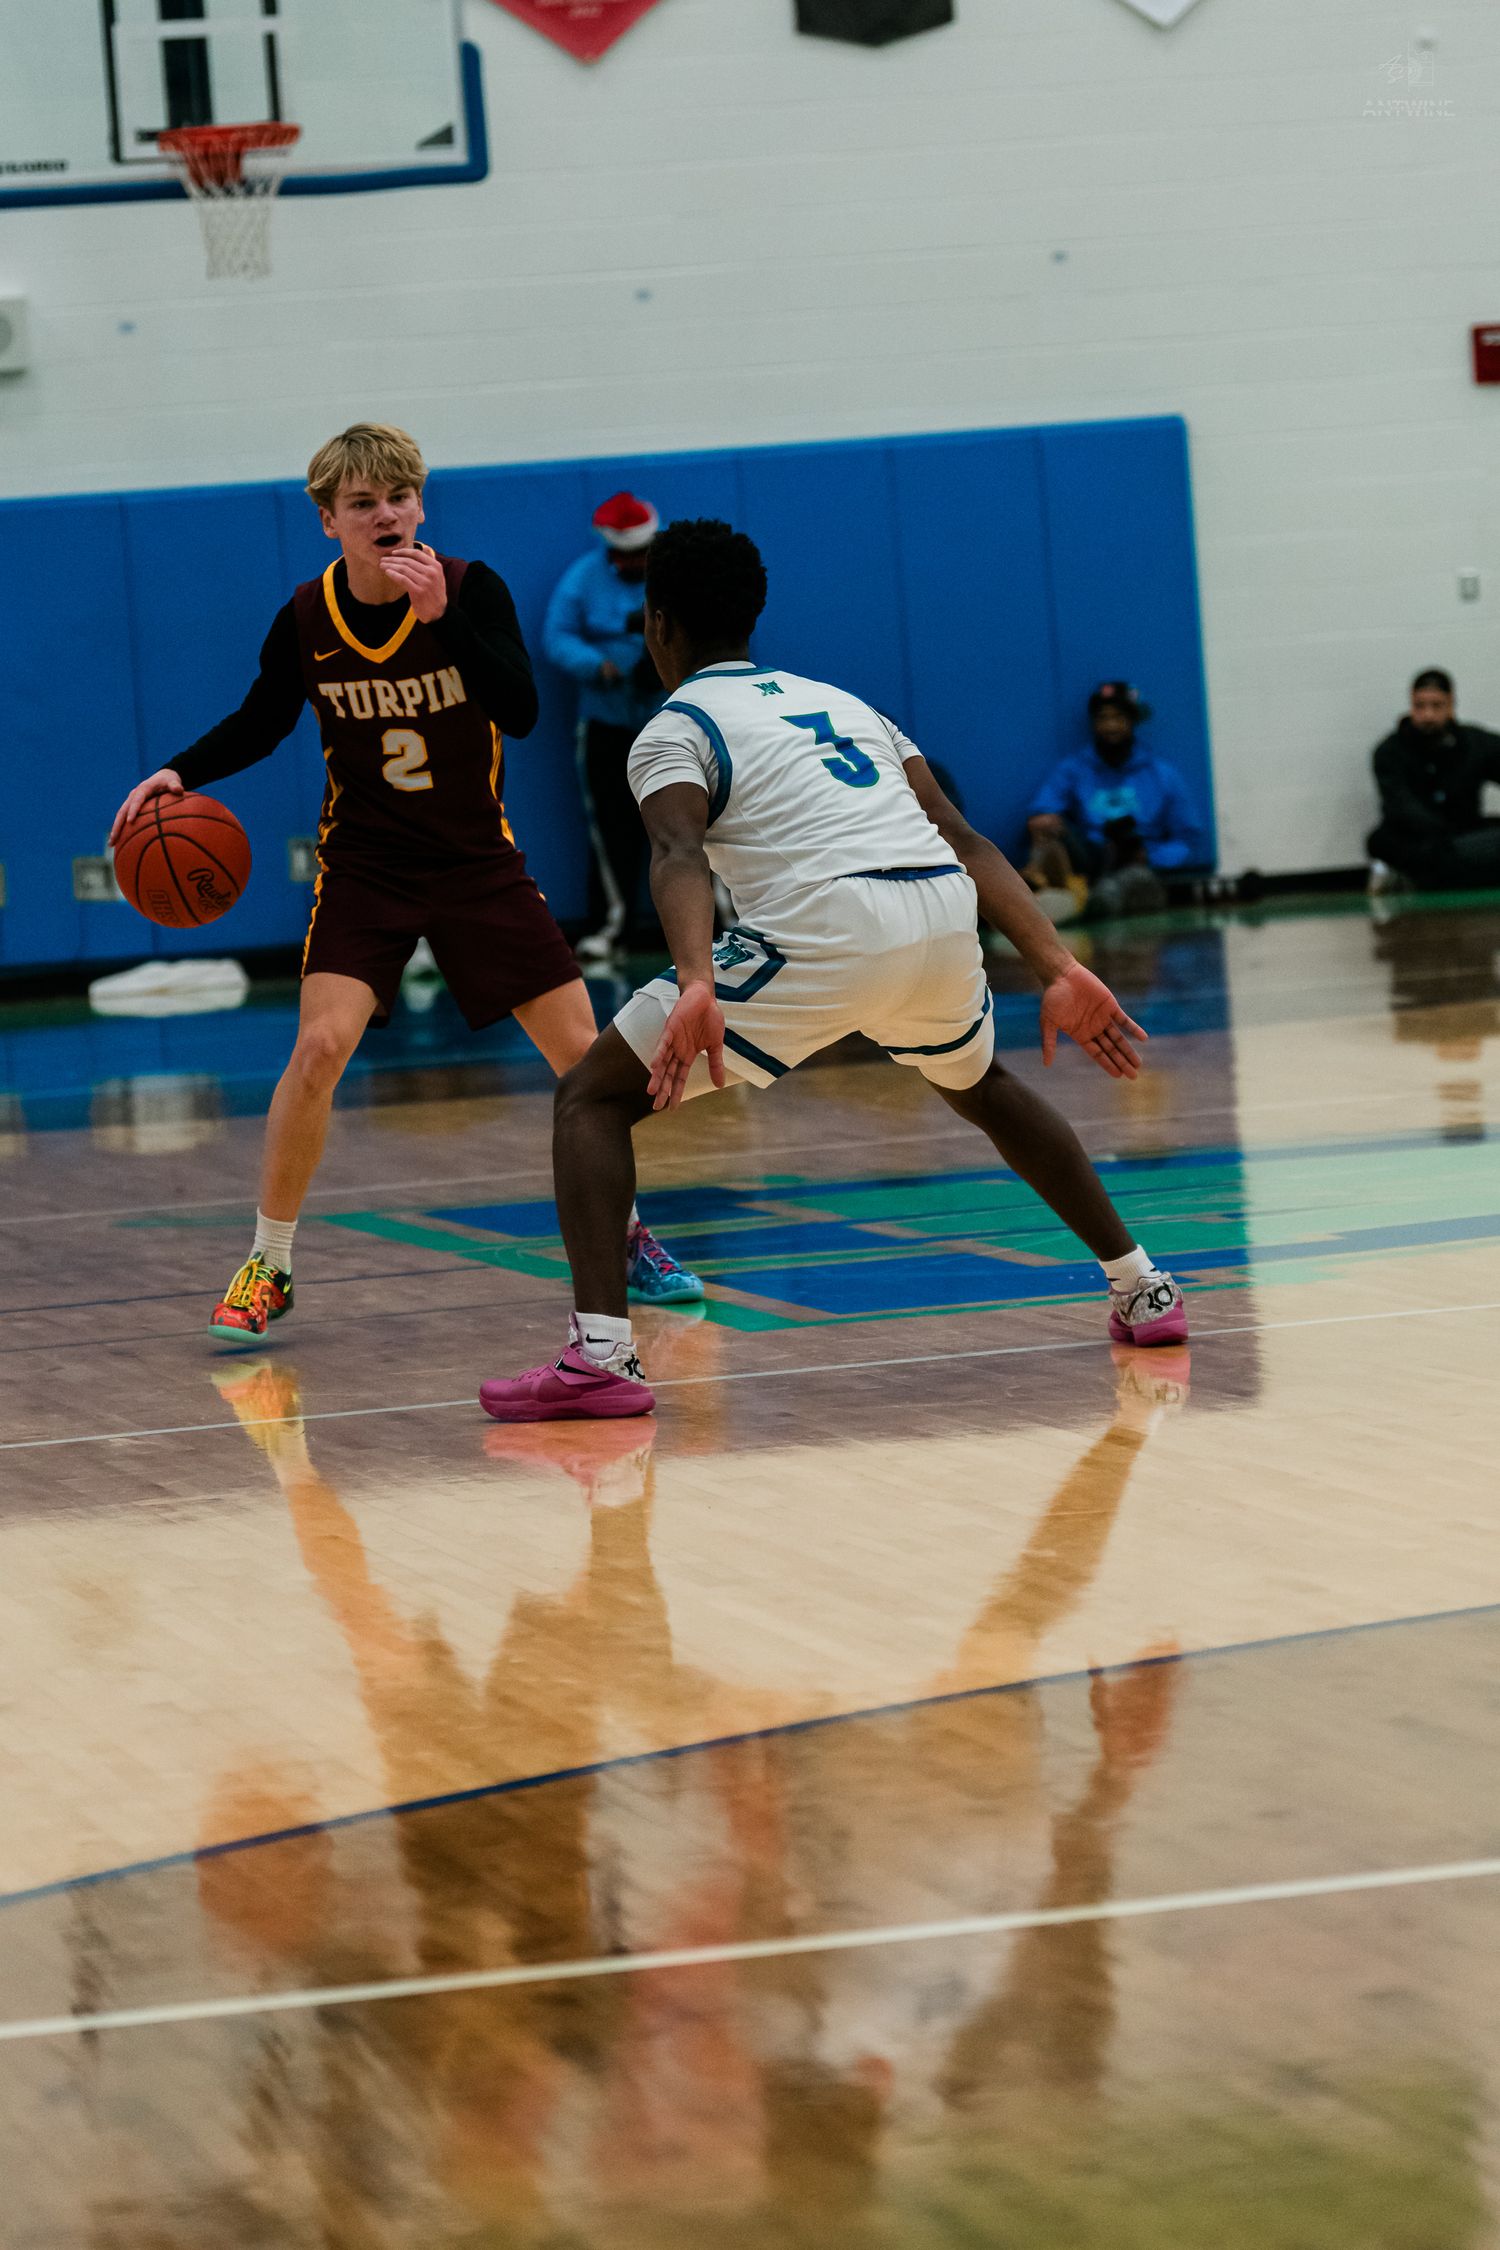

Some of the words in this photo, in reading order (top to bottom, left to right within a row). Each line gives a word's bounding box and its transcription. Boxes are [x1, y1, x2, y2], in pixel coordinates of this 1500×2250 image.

[317, 665, 467, 720] TURPIN
[381, 728, 434, 792] 2
[779, 710, 880, 788] 3
